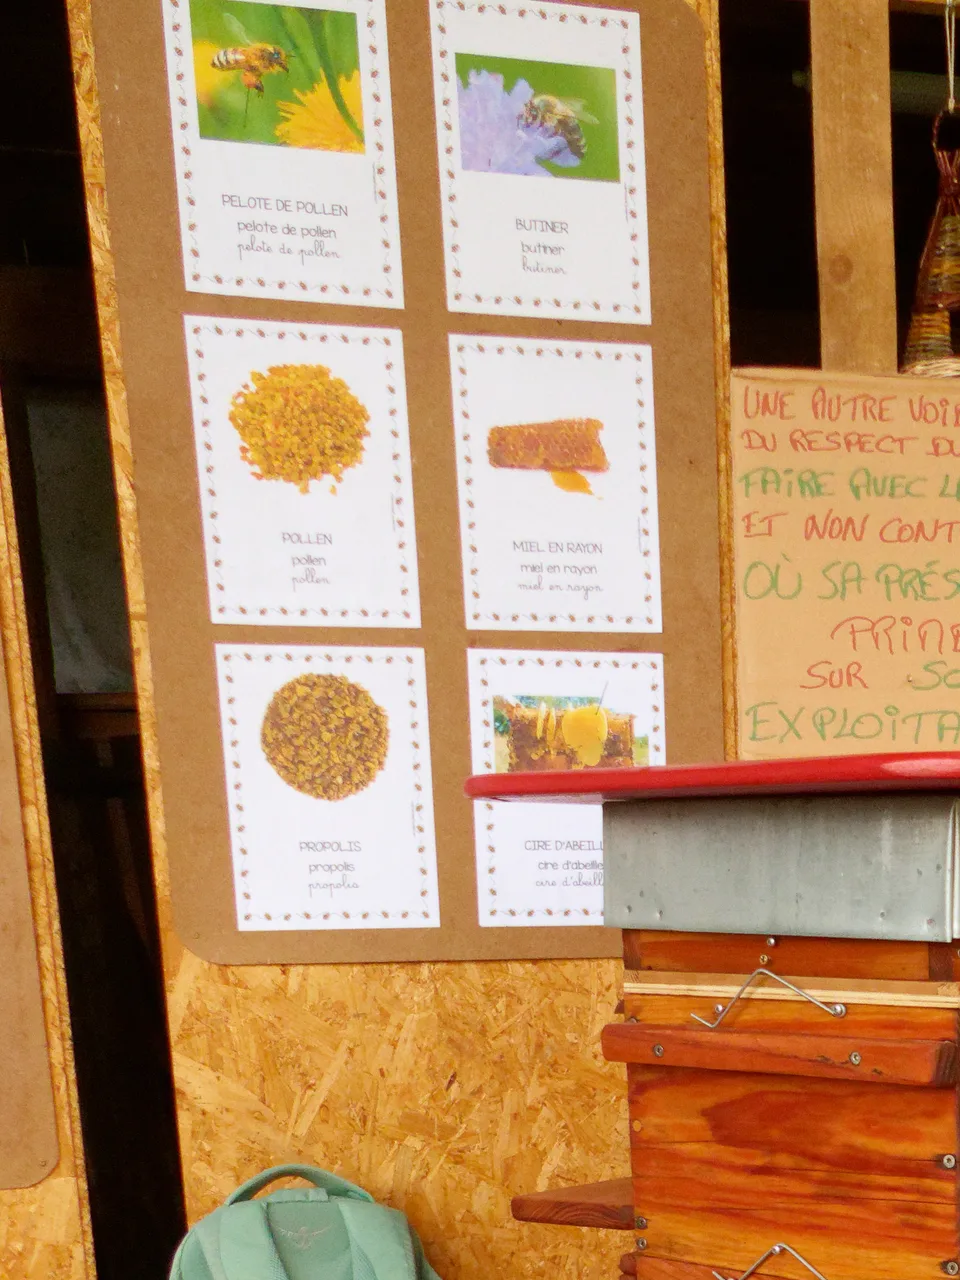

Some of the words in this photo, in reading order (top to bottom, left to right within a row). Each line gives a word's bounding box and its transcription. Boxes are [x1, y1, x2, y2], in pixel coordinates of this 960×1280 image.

[221, 193, 273, 211] PELOTE
[275, 198, 292, 213] DE
[296, 200, 348, 217] POLLEN
[237, 219, 278, 235] pelote
[281, 223, 297, 236] de
[301, 225, 337, 239] pollen
[515, 217, 570, 235] BUTINER
[237, 234, 273, 261] pelote
[278, 242, 294, 255] de
[298, 239, 341, 266] pollen
[520, 239, 566, 256] butiner
[521, 254, 568, 275] butiner
[743, 385, 797, 421] UNE
[811, 385, 898, 422] AUTRE
[741, 428, 778, 453] DU
[789, 428, 920, 455] RESPECT
[738, 465, 836, 499] FAIRE
[850, 466, 928, 501] AVEC
[741, 510, 790, 538] ET
[804, 508, 870, 542] NON
[281, 531, 333, 546] POLLEN
[512, 539, 546, 553] MIEL
[548, 541, 564, 554] EN
[566, 541, 604, 555] RAYON
[291, 553, 327, 568] pollen
[520, 561, 544, 573] miel
[546, 563, 561, 574] en
[563, 564, 598, 577] rayon
[291, 567, 331, 592] pollen
[743, 551, 803, 601] OÙ
[817, 560, 867, 601] SA
[517, 574, 545, 591] miel
[548, 584, 564, 592] en
[566, 583, 605, 601] rayon
[799, 660, 869, 690] SUR
[299, 840, 363, 853] PROPOLIS
[523, 839, 553, 852] CIRE
[554, 839, 604, 852] D'ABEILL
[308, 860, 356, 876] propolis
[537, 860, 560, 871] cire
[307, 873, 361, 899] propolis
[562, 871, 604, 888] d'abeill
